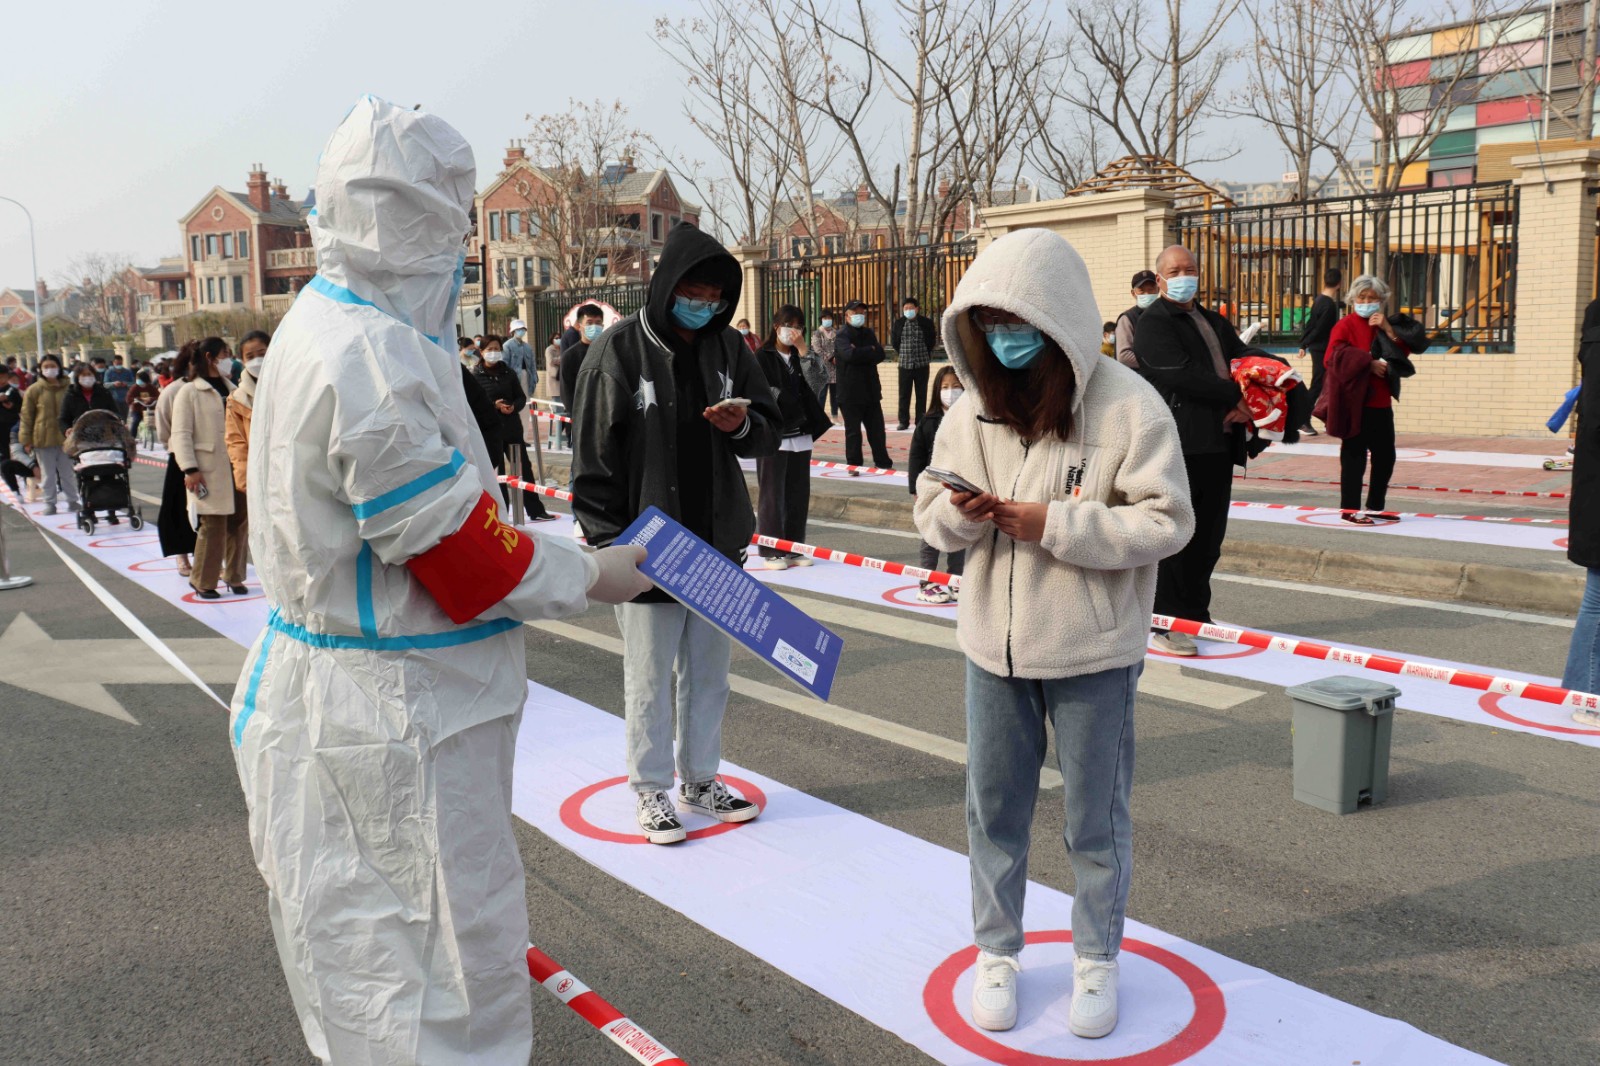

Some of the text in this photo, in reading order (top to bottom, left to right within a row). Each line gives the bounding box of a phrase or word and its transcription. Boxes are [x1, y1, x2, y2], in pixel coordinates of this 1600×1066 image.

[1065, 465, 1077, 495] Nature
[1152, 616, 1169, 628] 戒线
[1203, 625, 1237, 640] WARNING LIMIT
[1406, 663, 1449, 681] WARNING LIMIT
[1571, 694, 1597, 709] 警戒
[610, 1020, 665, 1062] WARNING LIMIT
